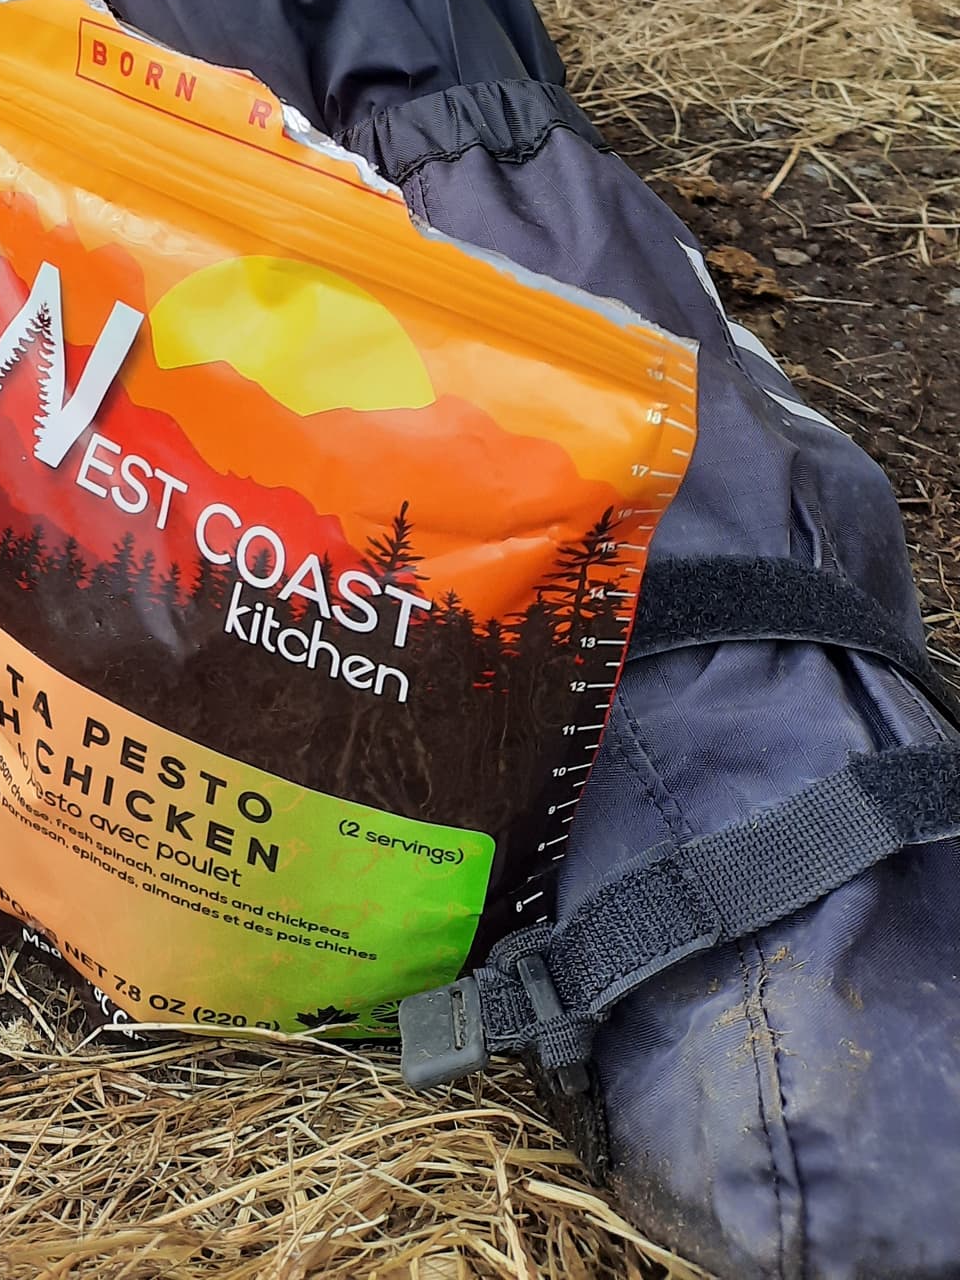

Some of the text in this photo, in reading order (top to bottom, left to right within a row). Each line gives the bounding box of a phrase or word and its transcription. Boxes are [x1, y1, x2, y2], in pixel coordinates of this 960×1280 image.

[91, 37, 274, 130] BORN R
[631, 464, 650, 478] 17
[194, 502, 433, 648] COAST
[588, 588, 605, 600] 14
[223, 581, 411, 704] kitchen
[580, 636, 596, 648] 13
[570, 681, 586, 692] 12
[562, 724, 576, 735] 11
[35, 738, 280, 873] CHICKEN
[82, 716, 274, 824] PESTO
[551, 766, 566, 777] 10
[2, 796, 69, 850] parmesan,
[142, 882, 220, 919] almandes
[223, 914, 241, 927] et
[243, 919, 274, 937] des
[276, 931, 312, 947] pois
[314, 939, 378, 961] chiches
[56, 817, 93, 845] fresh
[95, 840, 156, 877] spinach,
[159, 871, 228, 905] almonds
[231, 898, 264, 916] and
[266, 909, 351, 940] chickpeas
[90, 812, 150, 850] avec
[156, 841, 242, 888] poulet
[338, 819, 465, 866] (2 servings)
[515, 900, 523, 913] 6
[64, 940, 108, 979] NET
[113, 973, 142, 1003] 7.8
[148, 993, 187, 1016] OZ
[192, 1005, 248, 1030] (220
